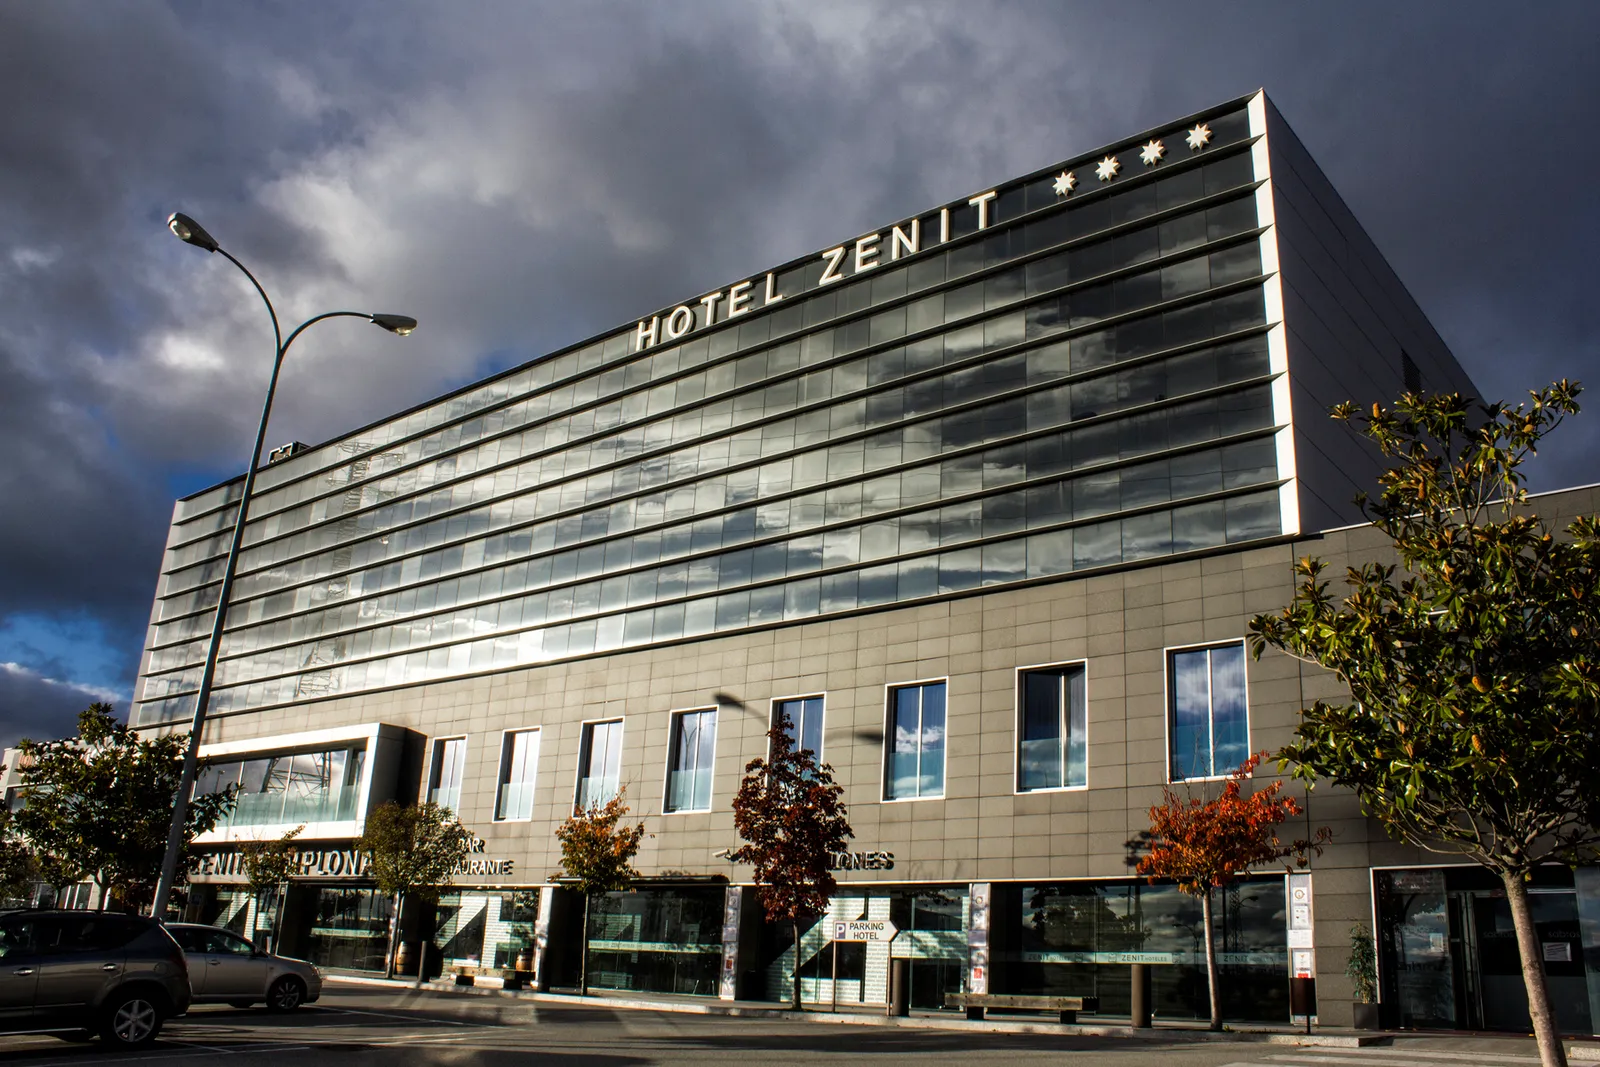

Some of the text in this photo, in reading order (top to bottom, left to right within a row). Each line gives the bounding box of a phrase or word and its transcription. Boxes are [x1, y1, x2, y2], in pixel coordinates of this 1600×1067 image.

[635, 190, 997, 352] HOTEL ZENIT
[849, 922, 884, 930] PARKING
[853, 932, 879, 940] HOTEL
[1121, 954, 1146, 962] ZENIT
[1223, 954, 1248, 962] ZENIT
